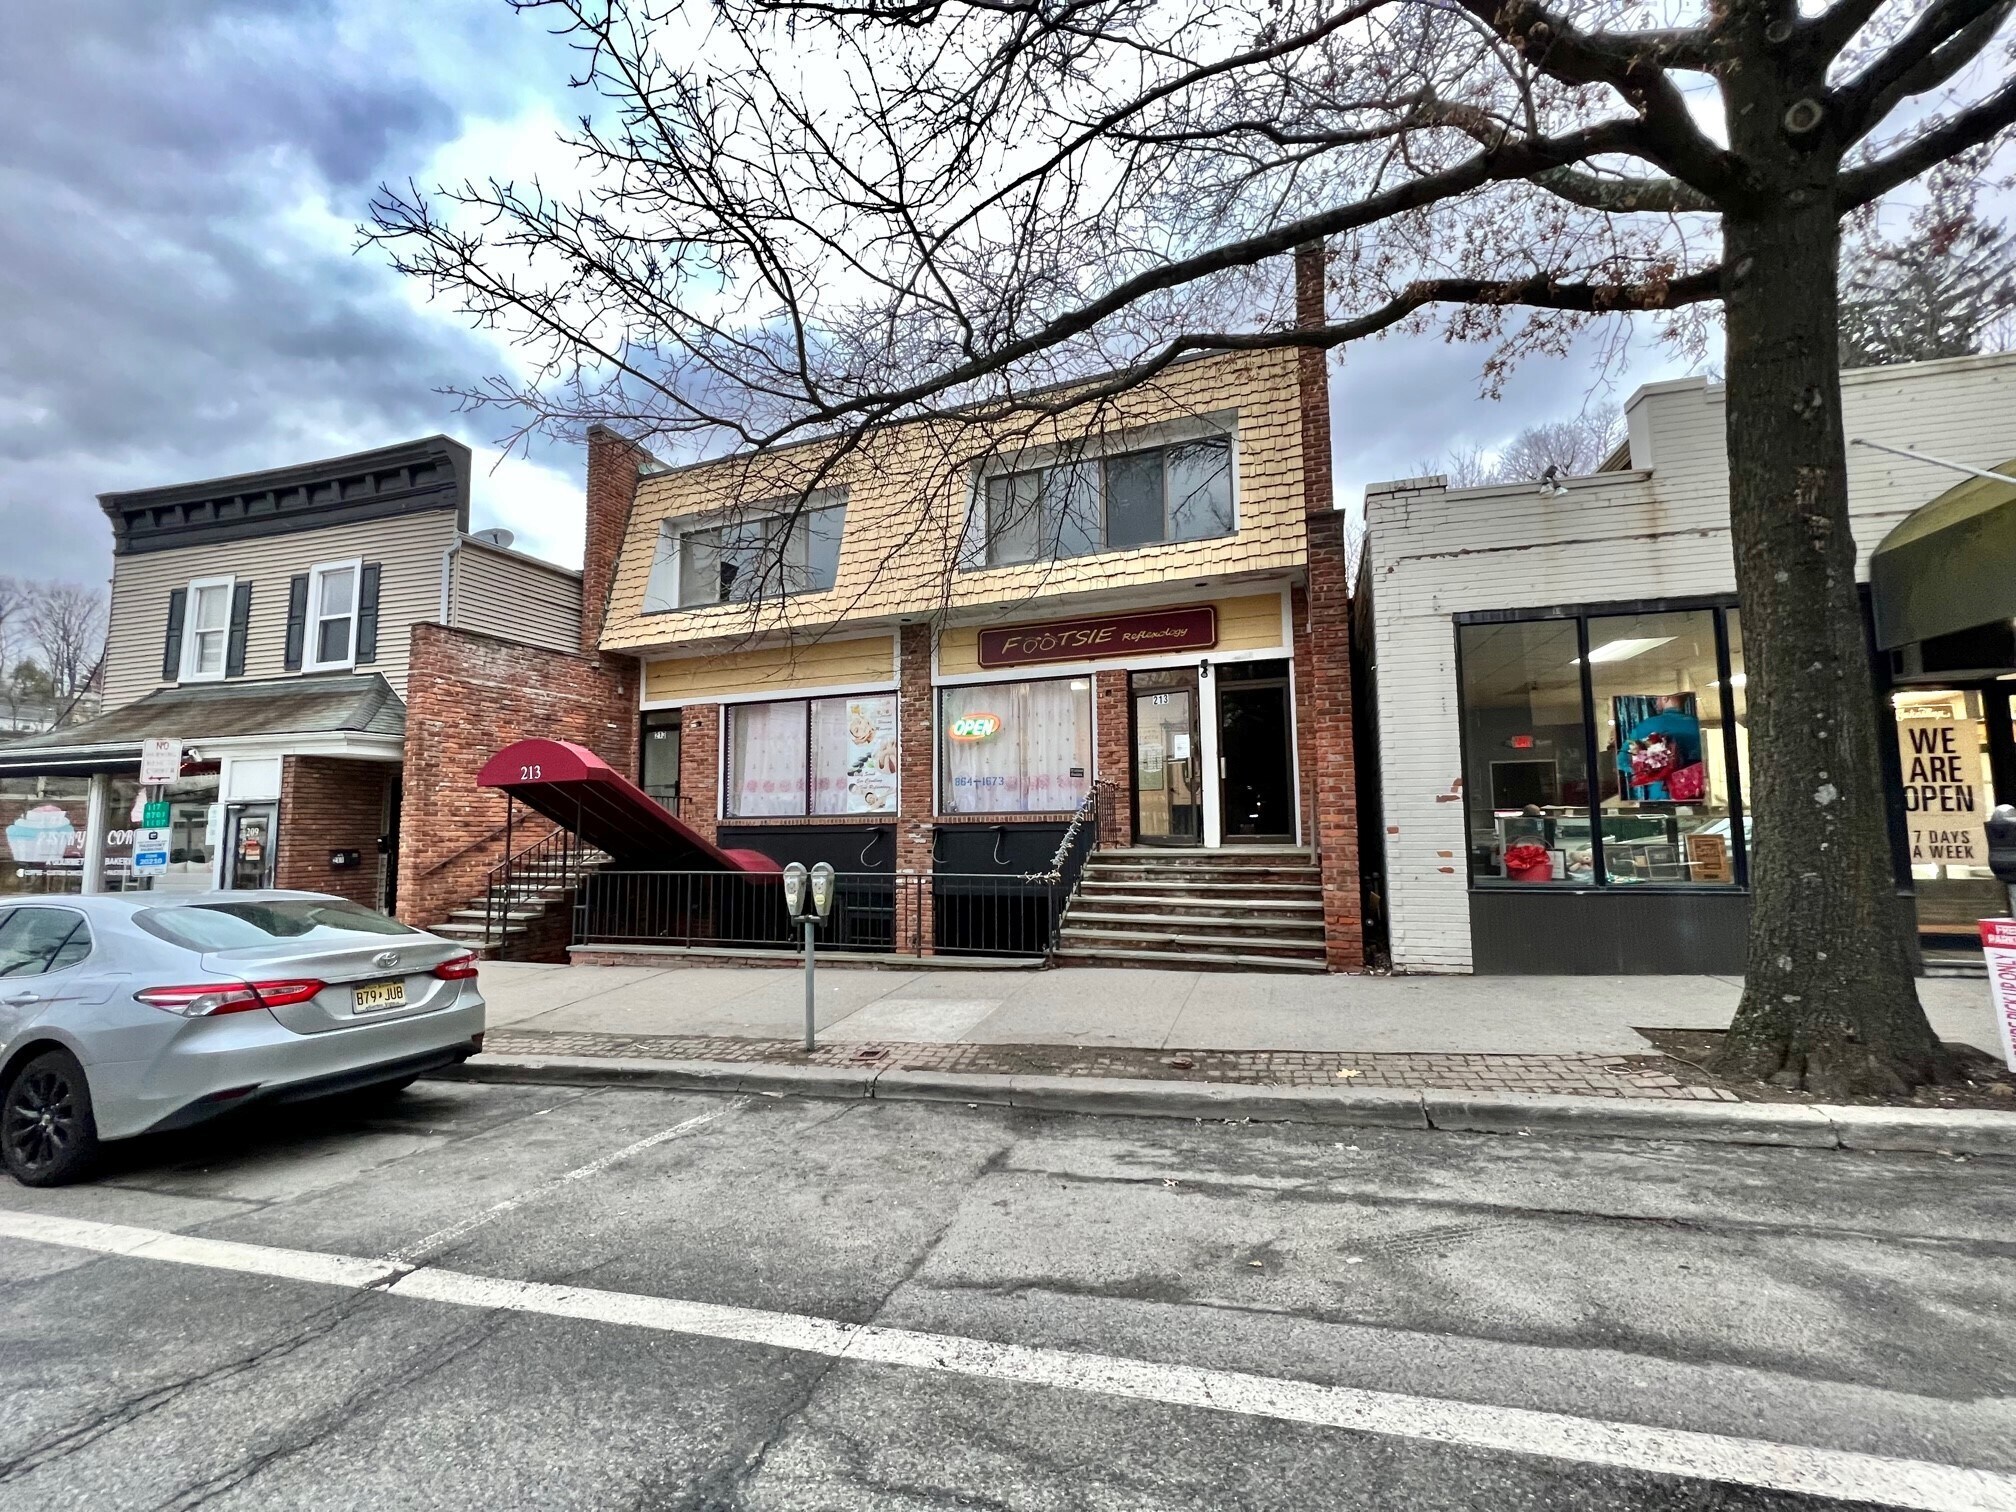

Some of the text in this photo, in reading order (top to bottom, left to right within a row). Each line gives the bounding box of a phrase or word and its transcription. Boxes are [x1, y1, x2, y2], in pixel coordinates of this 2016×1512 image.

[1001, 626, 1188, 655] FOOTSIE Reflexology
[1153, 694, 1169, 705] 213
[953, 719, 995, 736] OPEN
[156, 741, 170, 751] NO
[1908, 727, 1957, 754] WE
[520, 765, 542, 780] 213
[1909, 755, 1964, 783] ARE
[954, 776, 1005, 787] 864-1673
[1903, 785, 1975, 812] OPEN
[246, 827, 260, 837] 209
[1913, 830, 1970, 844] 7 DAYS
[1913, 845, 1974, 859] A WEEK
